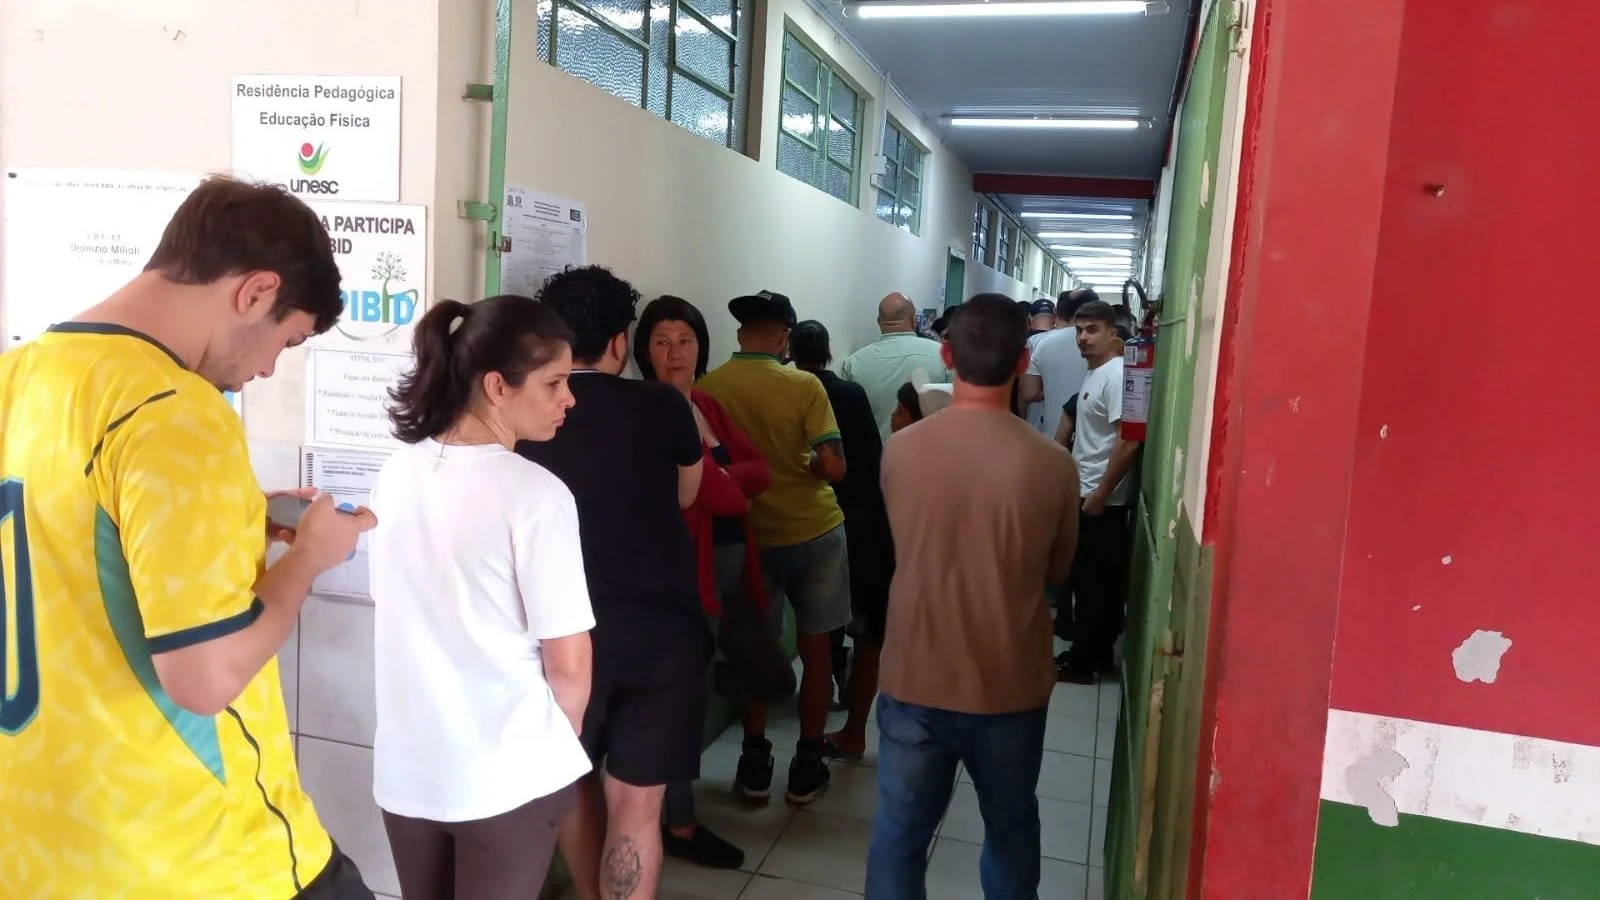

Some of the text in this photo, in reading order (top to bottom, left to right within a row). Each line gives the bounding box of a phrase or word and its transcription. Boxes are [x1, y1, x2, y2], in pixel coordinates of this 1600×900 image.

[236, 84, 395, 102] Residência Pedagógica
[259, 112, 325, 129] Educação
[290, 179, 339, 194] unesc
[334, 215, 415, 235] PARTICIPA
